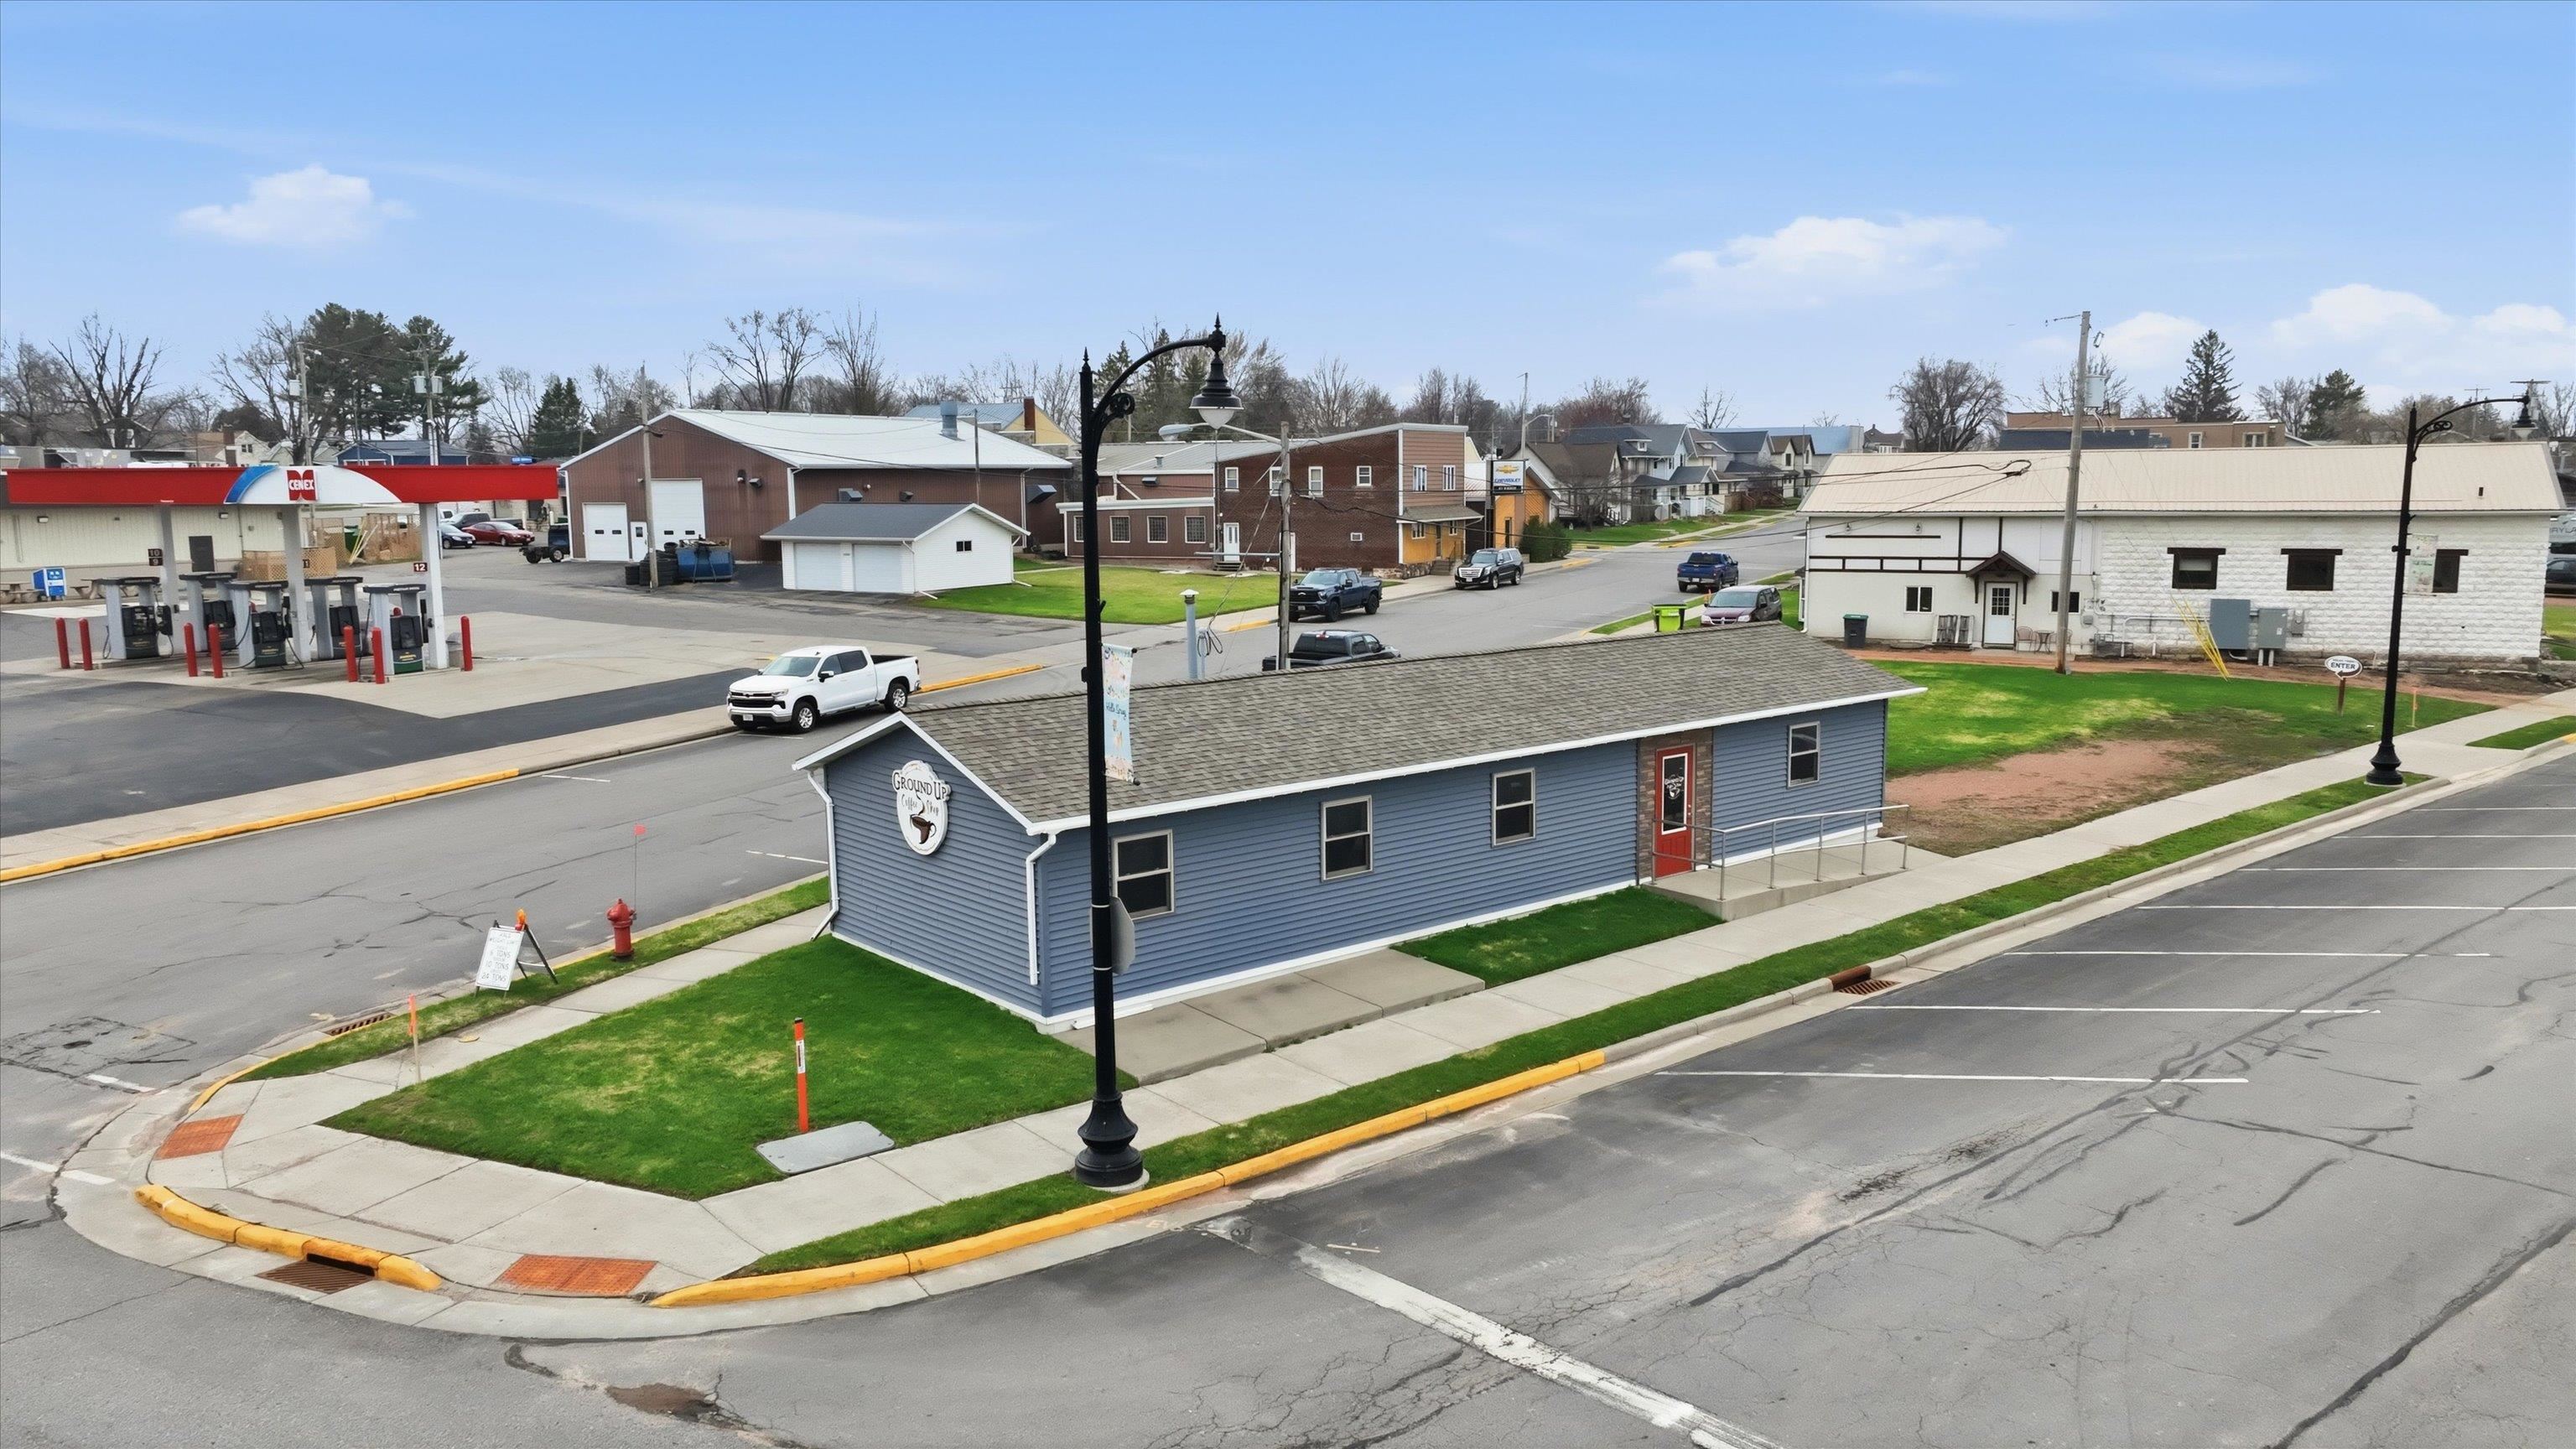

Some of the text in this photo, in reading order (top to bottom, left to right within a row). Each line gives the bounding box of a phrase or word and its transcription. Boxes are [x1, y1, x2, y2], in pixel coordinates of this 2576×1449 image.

[288, 479, 315, 491] CENEX
[2331, 662, 2356, 670] ENTER
[893, 771, 947, 801] GROUND UP
